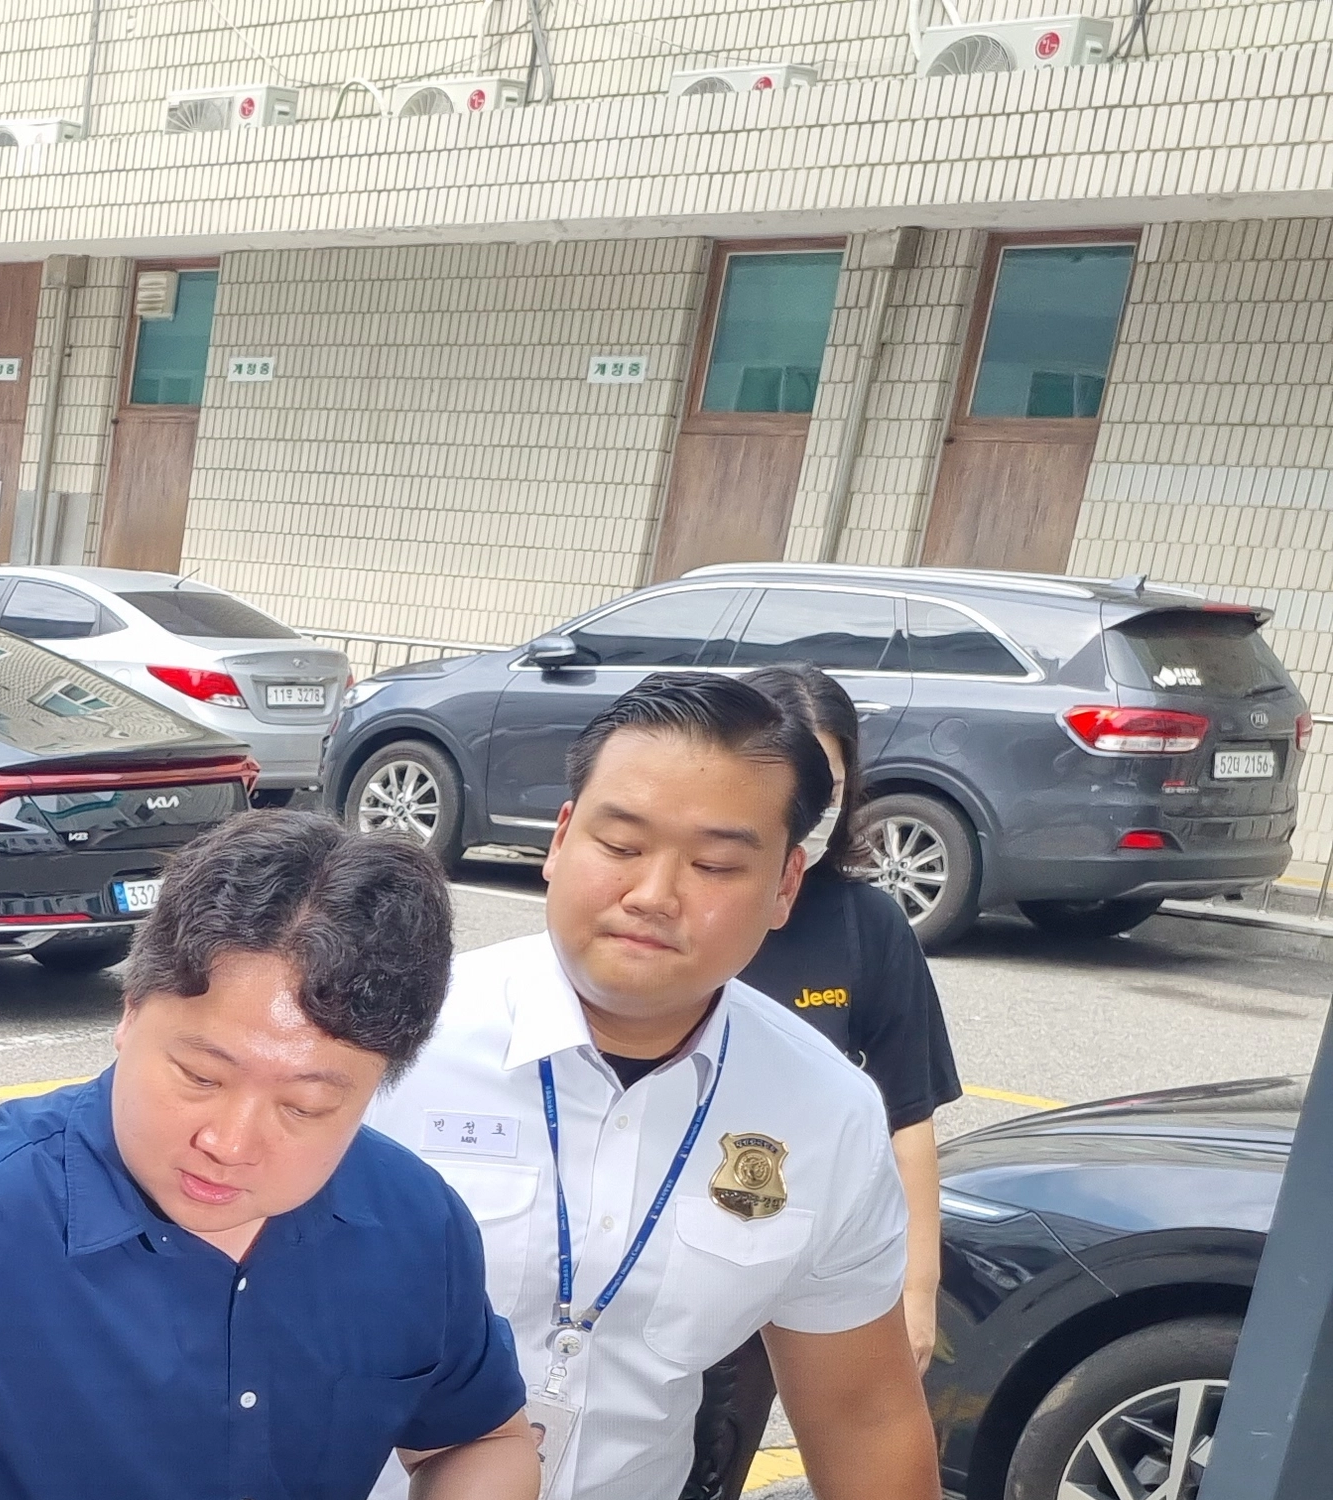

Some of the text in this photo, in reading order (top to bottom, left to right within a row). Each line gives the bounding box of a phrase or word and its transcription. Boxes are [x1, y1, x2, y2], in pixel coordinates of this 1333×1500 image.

[1244, 754, 1269, 775] 2156
[127, 884, 162, 907] 332
[794, 988, 848, 1008] Jeep
